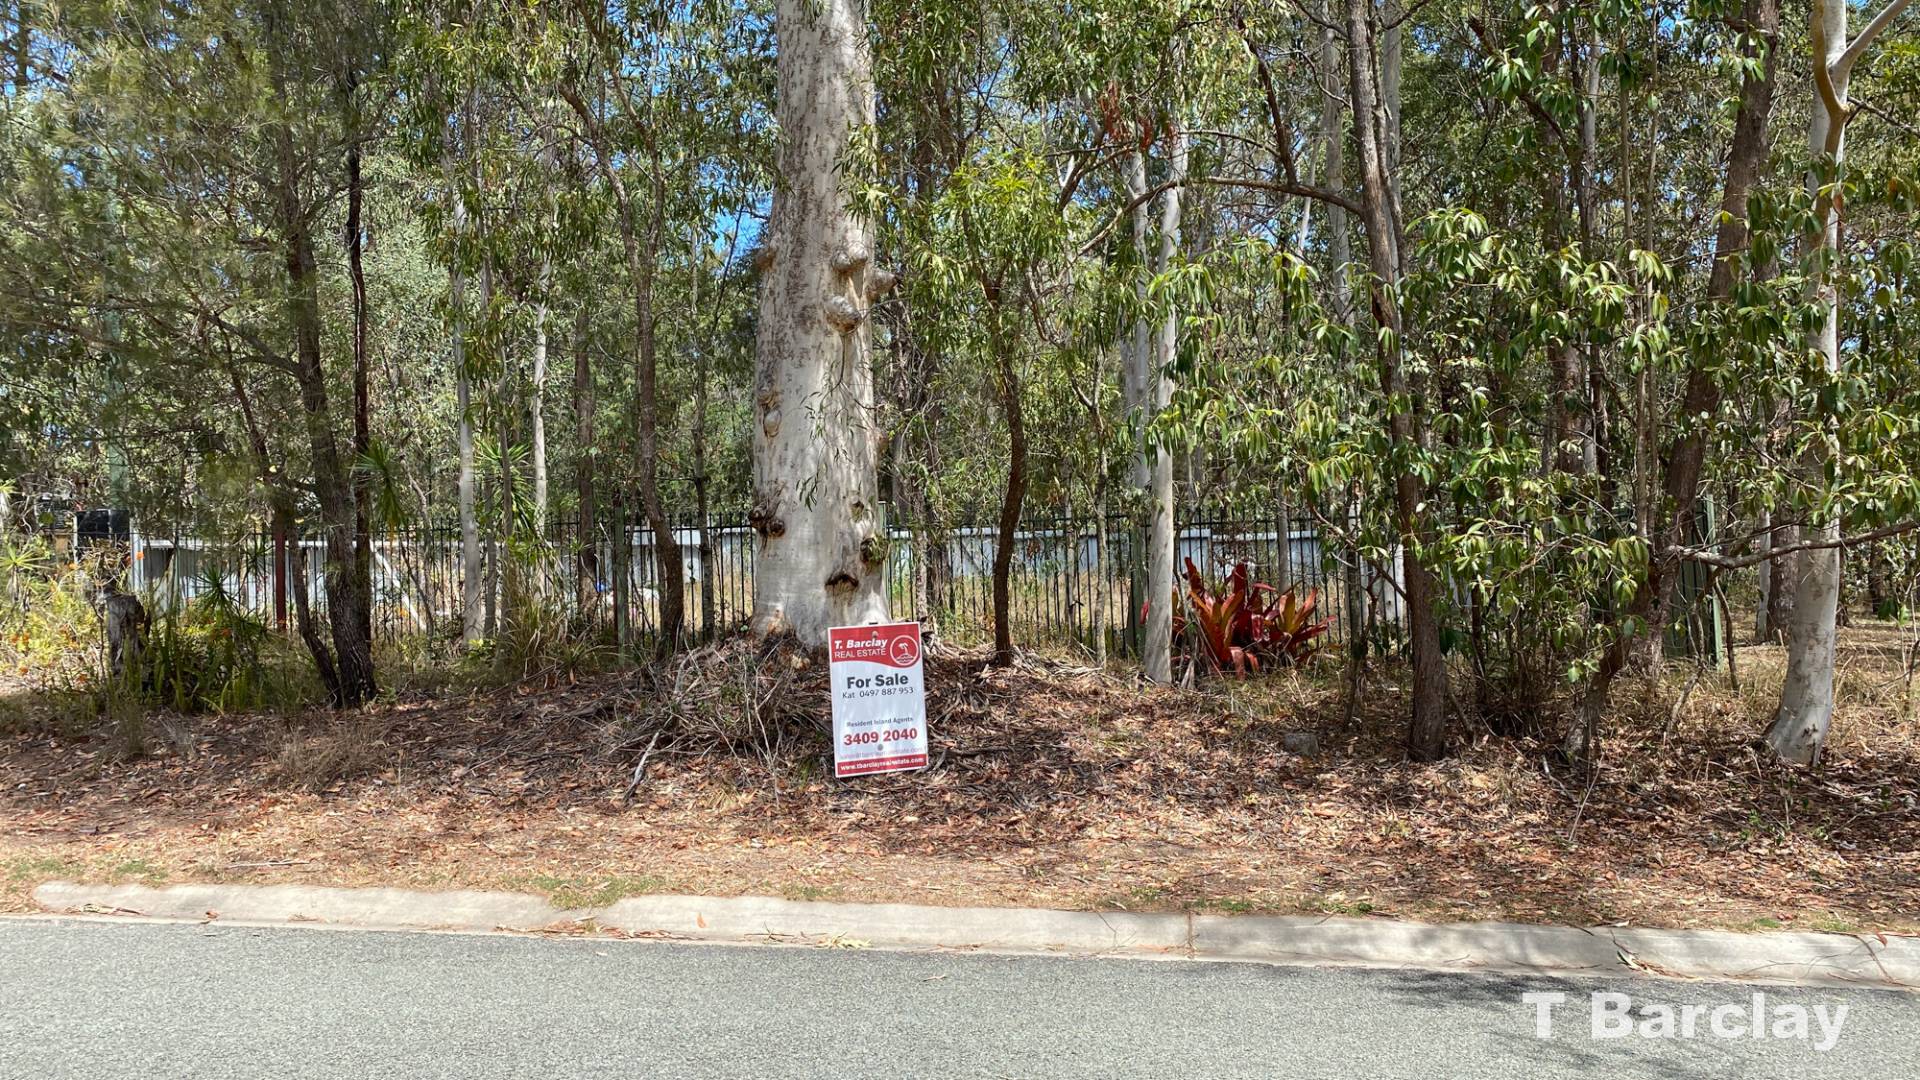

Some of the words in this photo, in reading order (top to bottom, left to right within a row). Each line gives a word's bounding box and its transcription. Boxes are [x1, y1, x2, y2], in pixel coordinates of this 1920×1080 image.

[834, 640, 843, 649] T.
[846, 638, 888, 649] Barclay
[834, 651, 855, 659] REAL
[857, 648, 886, 657] ESTATE
[847, 676, 871, 689] For
[875, 673, 909, 687] Sale
[842, 691, 855, 699] Kat
[859, 689, 879, 698] 0497
[881, 687, 897, 696] 887
[898, 686, 914, 694] 953
[843, 731, 879, 746] 3409
[882, 727, 918, 742] 2040
